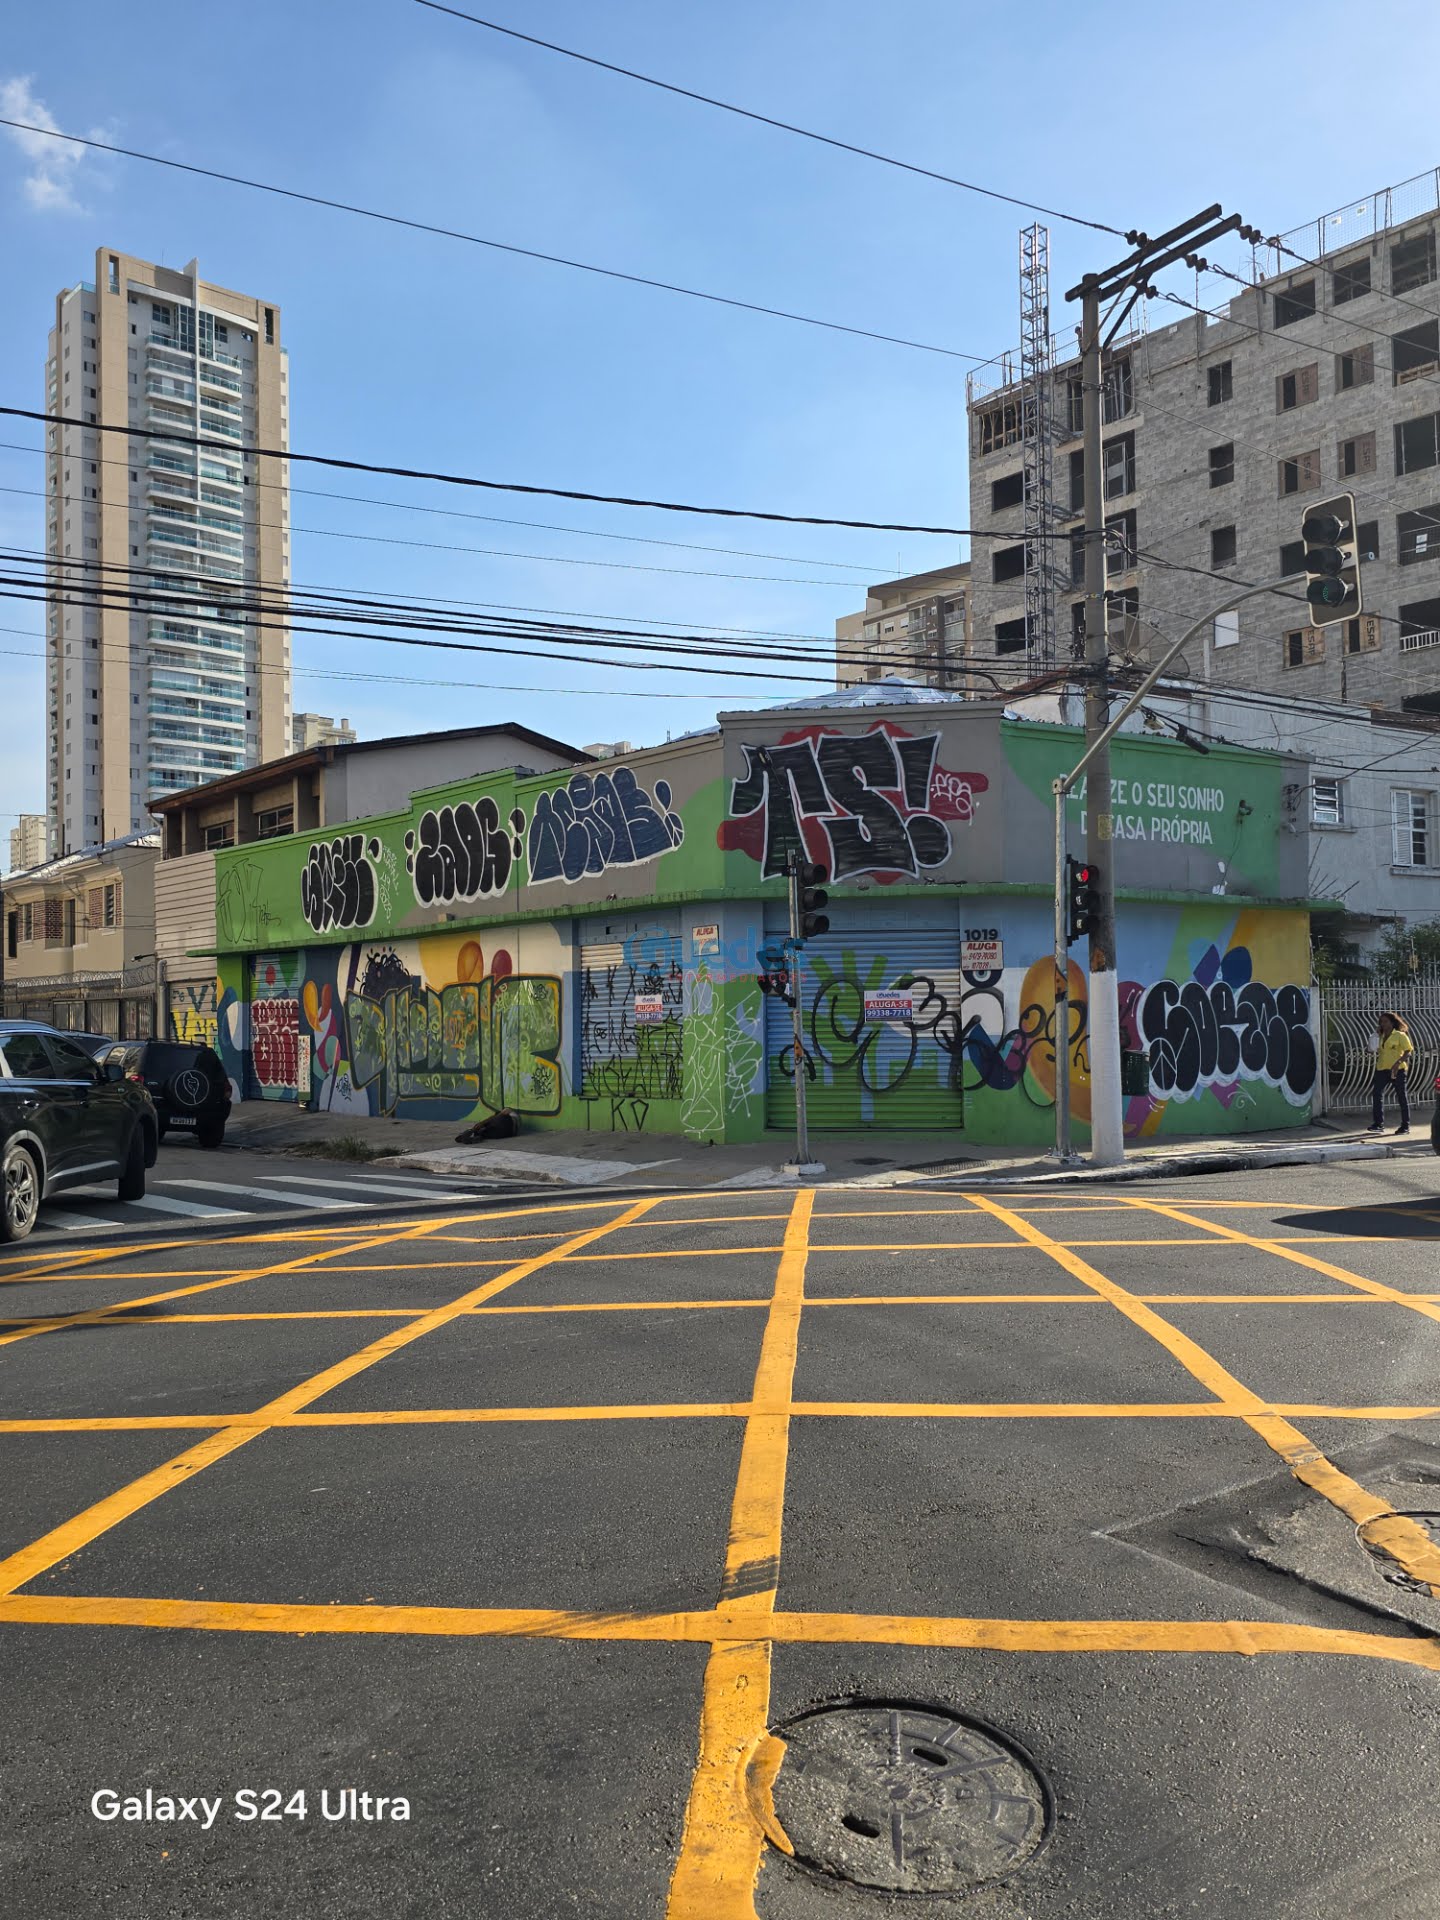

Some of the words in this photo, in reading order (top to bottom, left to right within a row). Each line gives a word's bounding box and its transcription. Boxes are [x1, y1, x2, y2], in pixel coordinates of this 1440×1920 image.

[1132, 782, 1143, 806] O
[1147, 784, 1174, 808] SEU
[1178, 786, 1225, 812] SONHO
[1110, 814, 1147, 841] ASA
[1151, 814, 1213, 844] PRÓPRIA
[964, 928, 999, 941] 1019
[967, 942, 997, 950] ALUGA
[869, 1000, 909, 1008] ALUGA-SE
[866, 1009, 911, 1017] 99338-7718
